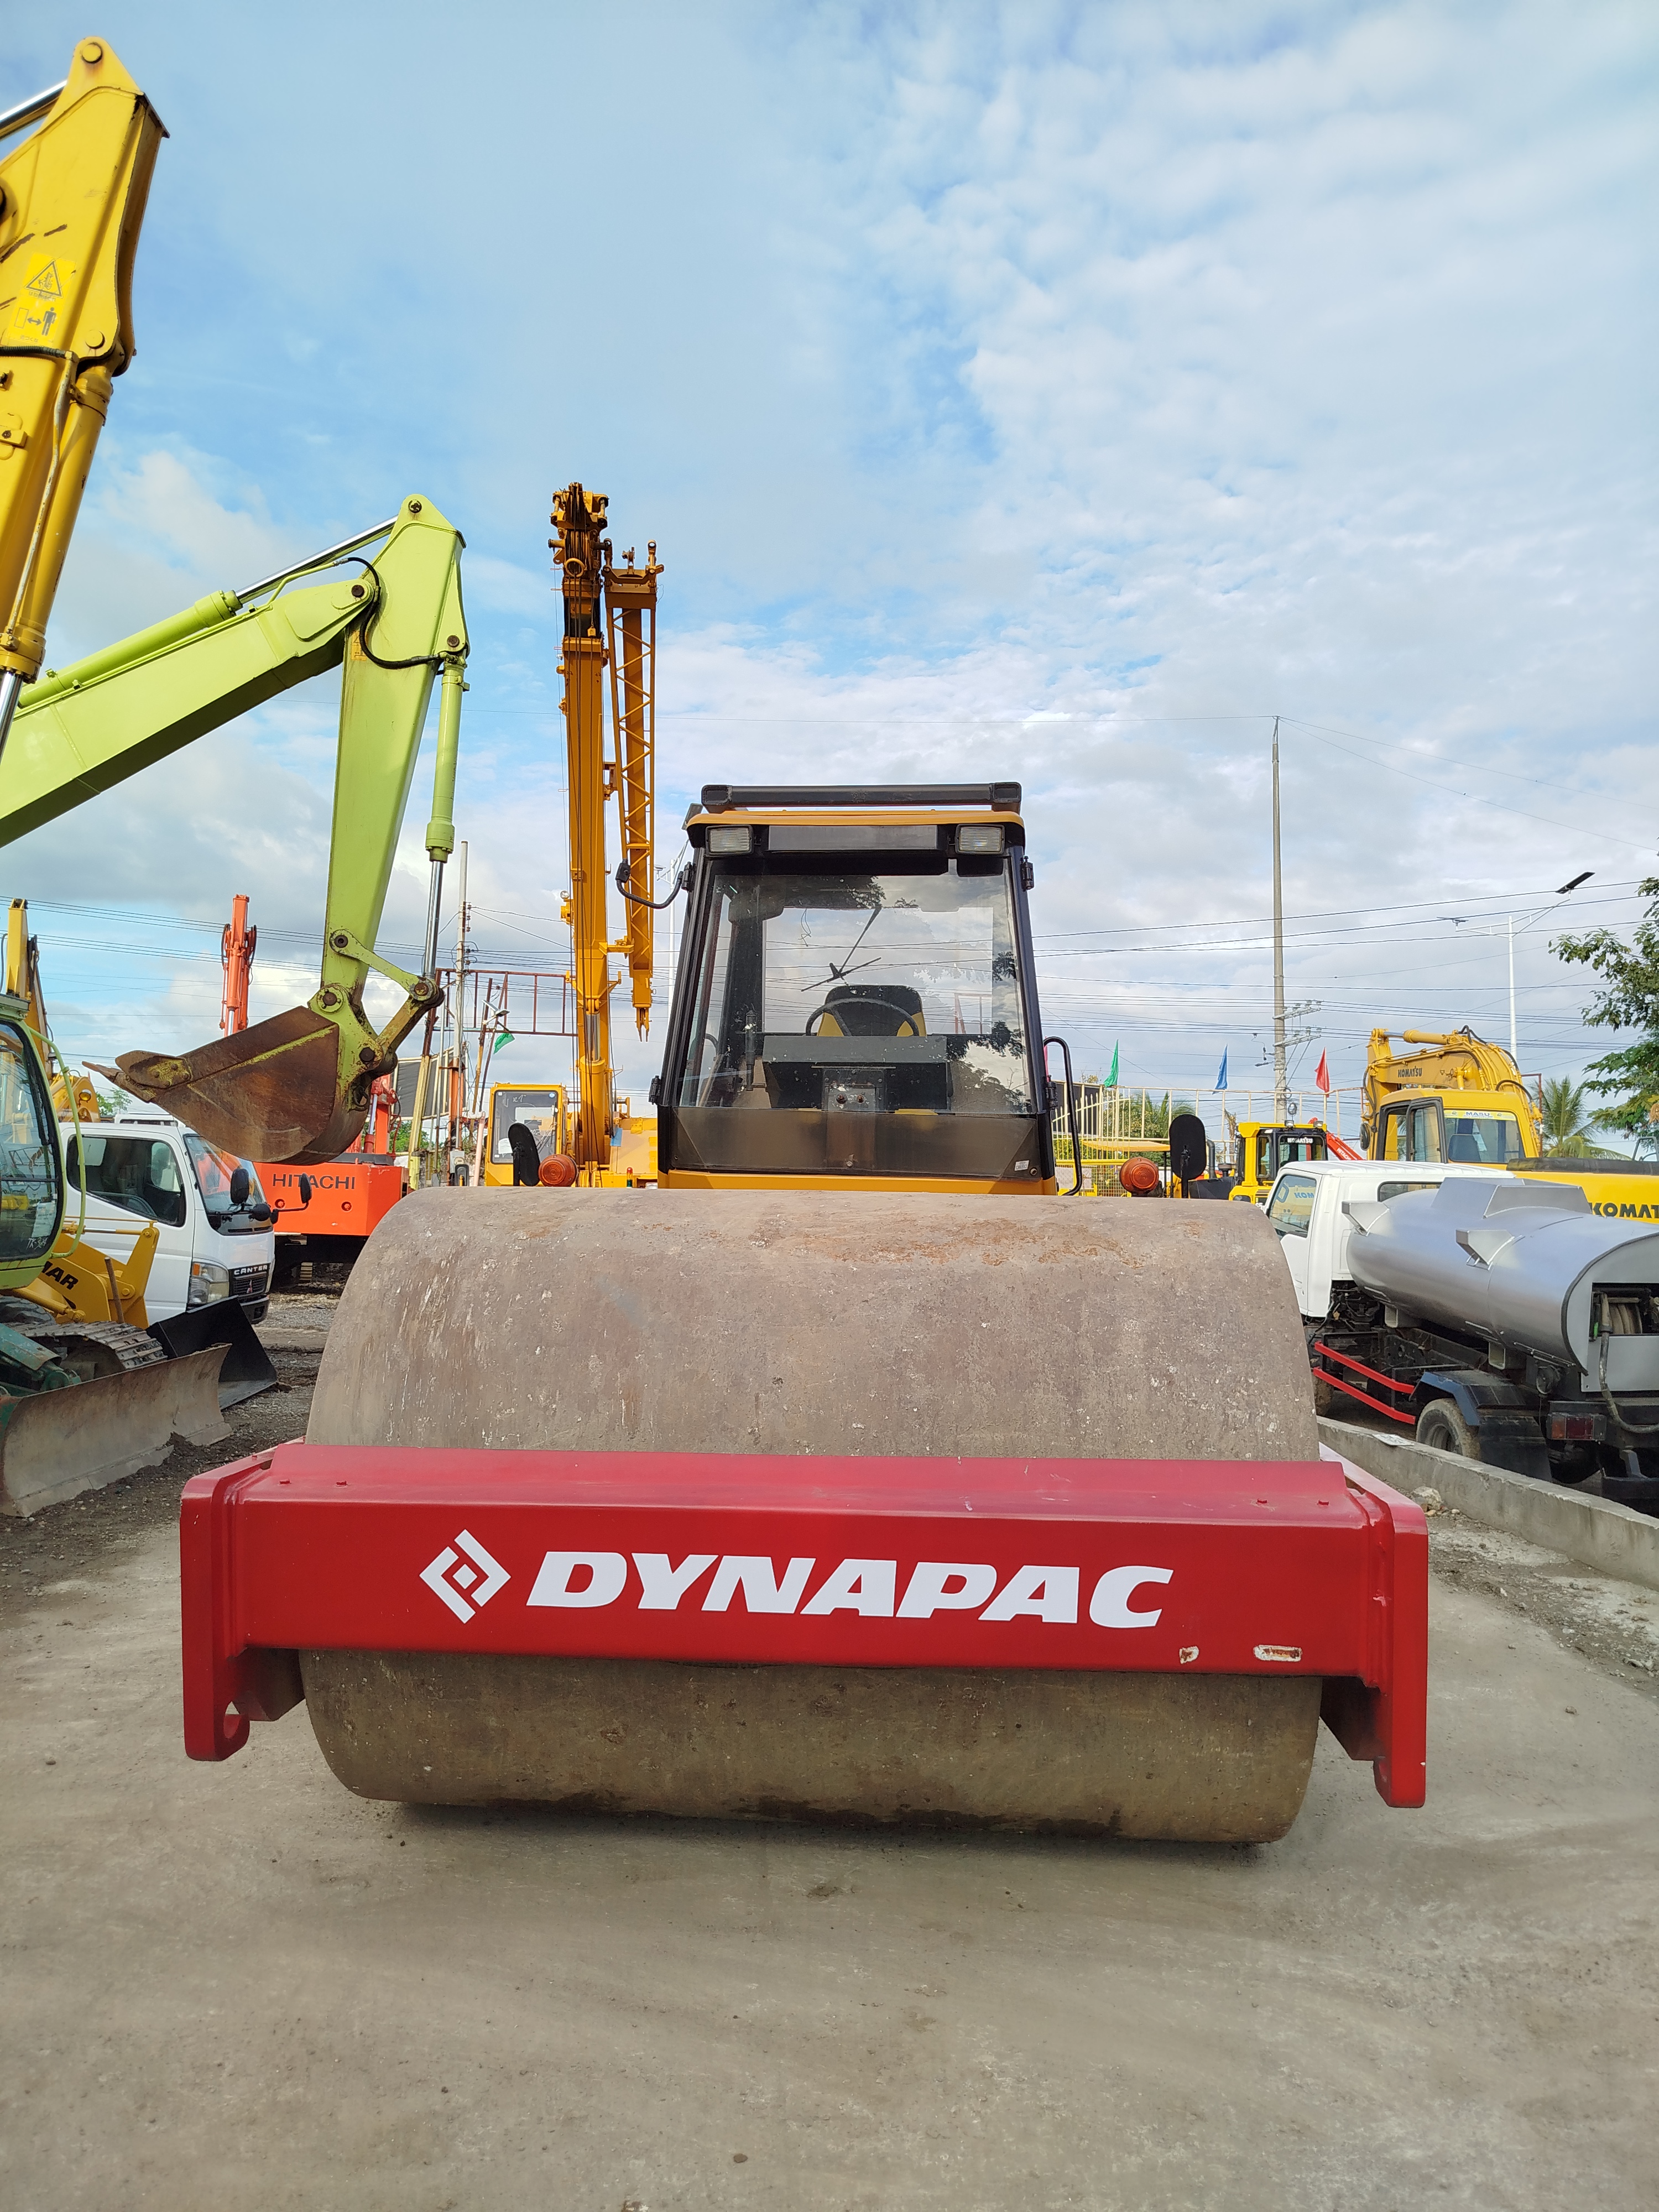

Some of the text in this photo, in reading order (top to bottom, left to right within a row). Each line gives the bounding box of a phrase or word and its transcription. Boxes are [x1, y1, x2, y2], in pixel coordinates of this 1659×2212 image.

[1397, 1066, 1422, 1078] KOMATSU
[234, 1265, 268, 1275] CANTER
[526, 1551, 1174, 1628] DYNAPAC
